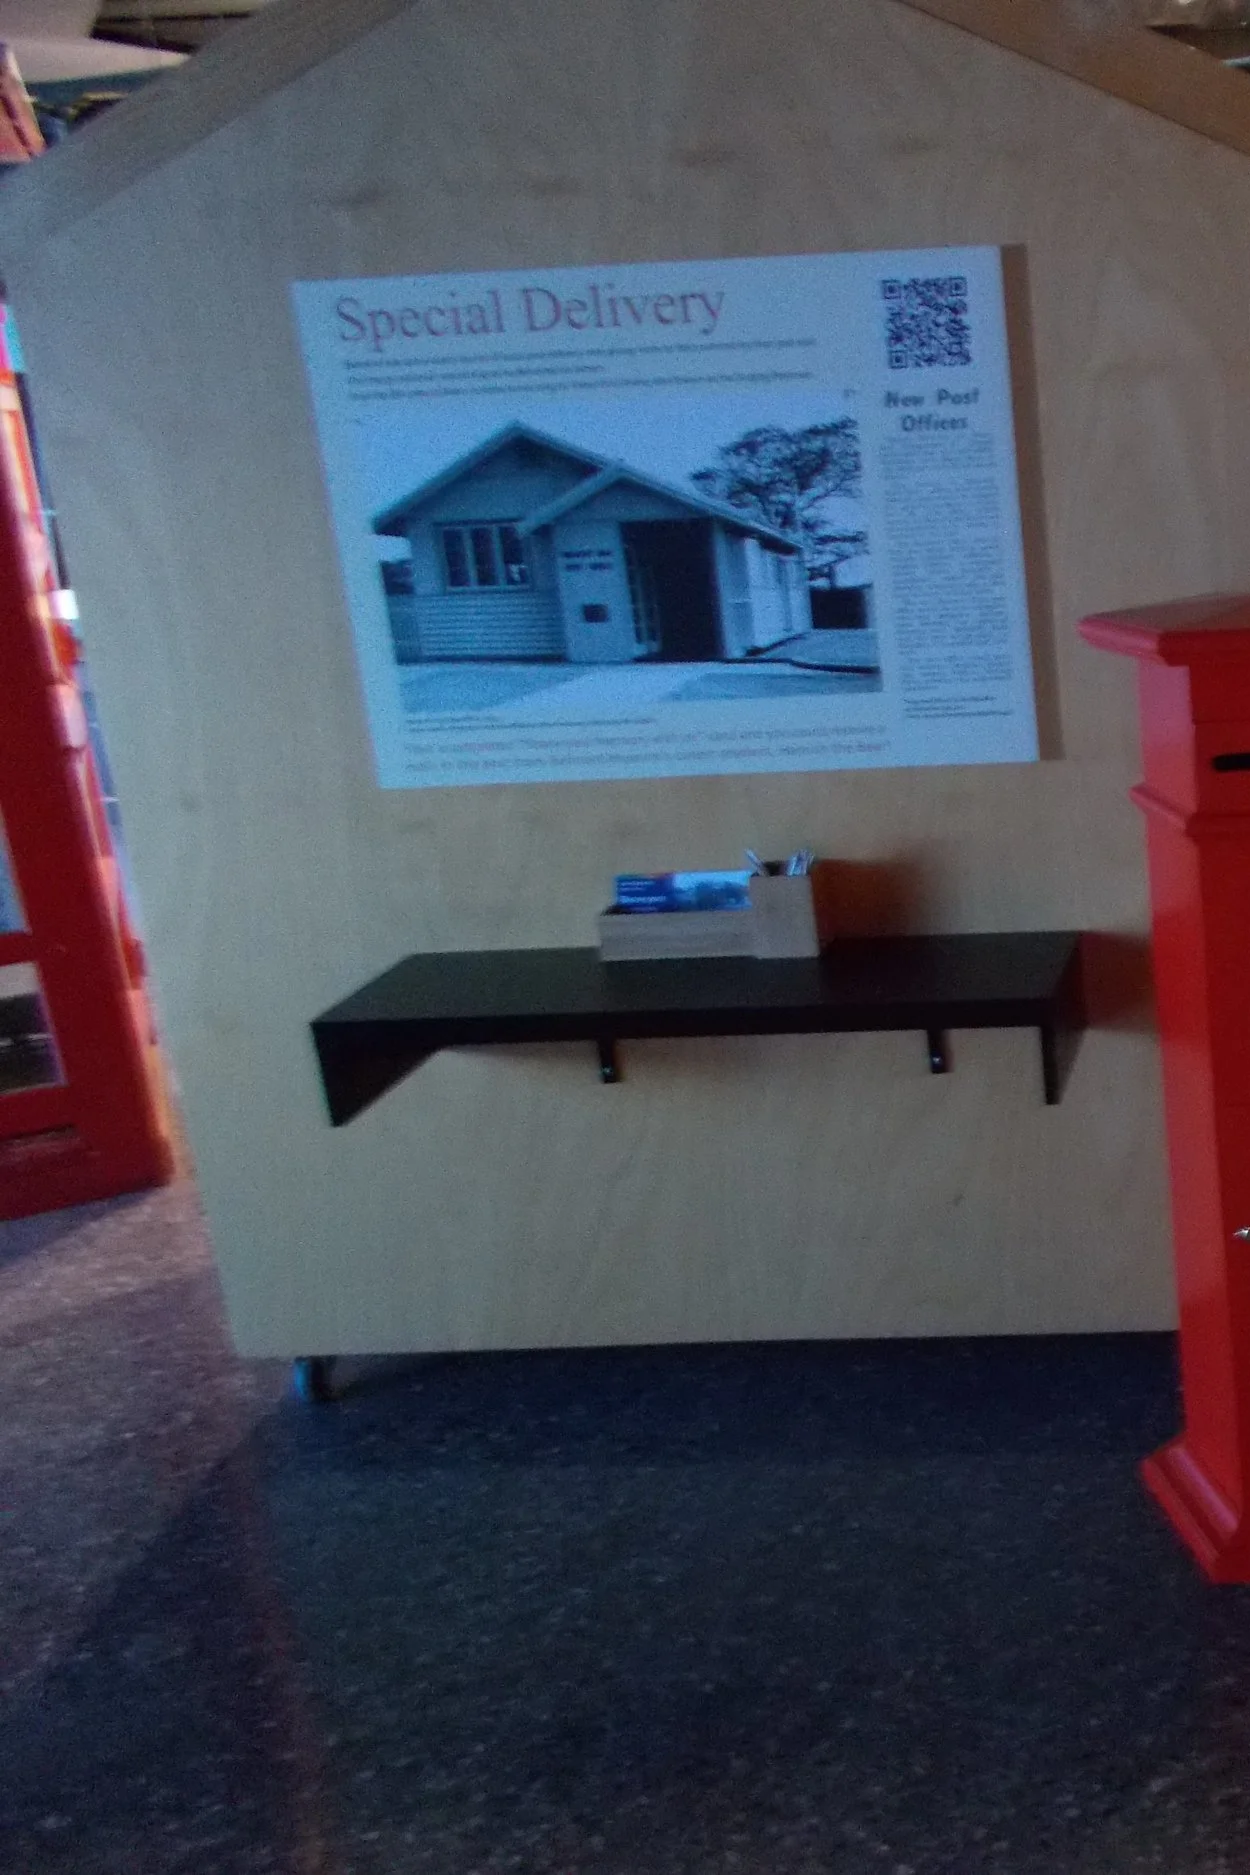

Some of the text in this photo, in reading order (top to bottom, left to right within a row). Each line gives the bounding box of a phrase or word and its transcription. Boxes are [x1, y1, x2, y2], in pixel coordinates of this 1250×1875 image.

[335, 294, 507, 354] Special
[521, 281, 725, 336] Delivery
[884, 387, 979, 408] New Post
[901, 414, 968, 431] Offices
